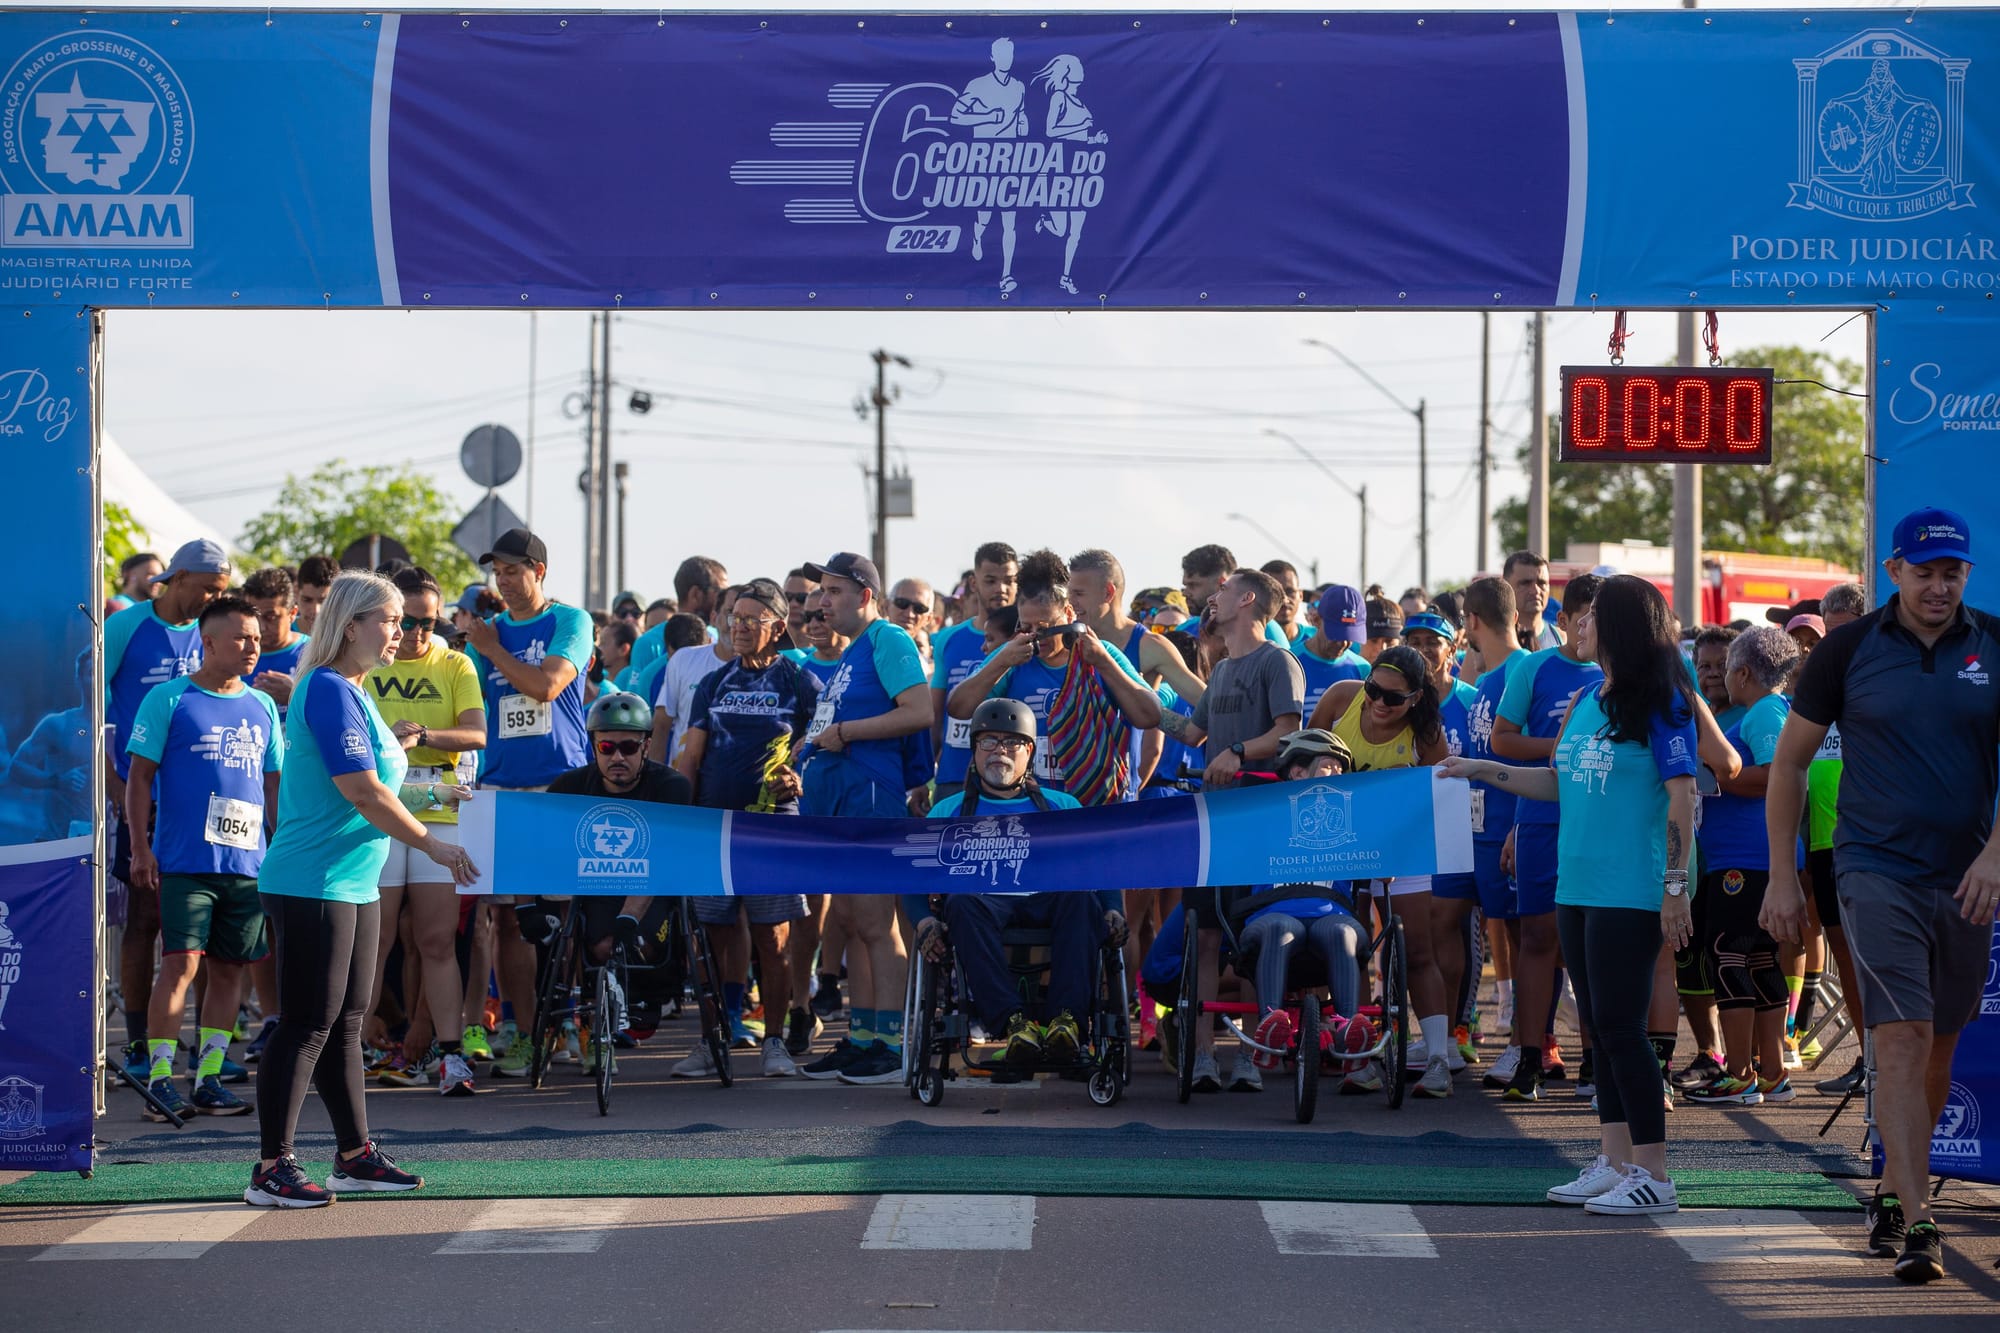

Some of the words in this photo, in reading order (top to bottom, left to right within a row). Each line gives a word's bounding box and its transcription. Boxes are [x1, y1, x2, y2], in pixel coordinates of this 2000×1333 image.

[3, 81, 25, 164] ASSOCIAÇÃO
[23, 40, 138, 82] MATO-GROSSENSE
[137, 56, 156, 74] DE
[153, 72, 184, 166] MAGISTRADOS
[923, 142, 1064, 174] CORRIDA
[1072, 151, 1106, 173] DO
[922, 173, 1105, 208] JUDICIÁRIO
[1812, 185, 1843, 210] SUUM
[1848, 201, 1891, 217] CUIQUE
[1896, 186, 1951, 214] TRIBUERE
[14, 203, 183, 237] AMAM
[895, 229, 951, 249] 2024
[1730, 234, 1841, 261] PODER
[1, 257, 132, 269] MAGISTRATURA
[138, 257, 193, 269] UNIDA
[2, 273, 119, 289] JUDICIÁRIO
[129, 277, 193, 289] FORTE
[1731, 269, 1818, 288] ESTADO
[1827, 271, 1857, 289] DE
[1866, 269, 1933, 289] MATO
[1572, 377, 1761, 449] 00:00
[1928, 524, 1956, 532] Triathlon
[507, 710, 536, 729] 593
[953, 723, 971, 739] 37
[215, 816, 249, 837] 1054
[962, 837, 1014, 850] CORRIDA
[1016, 839, 1030, 848] DO
[962, 847, 1030, 861] JUDICIÁRIO
[1269, 855, 1309, 866] PODER
[1312, 849, 1380, 864] JUDICIÁRIO
[582, 861, 645, 873] AMAM
[1, 953, 21, 966] DO
[1984, 1001, 2000, 1012] 20
[3, 1142, 66, 1154] JUDICIÁRIO
[1930, 1142, 1977, 1153] MAM
[265, 1179, 280, 1191] FILA
